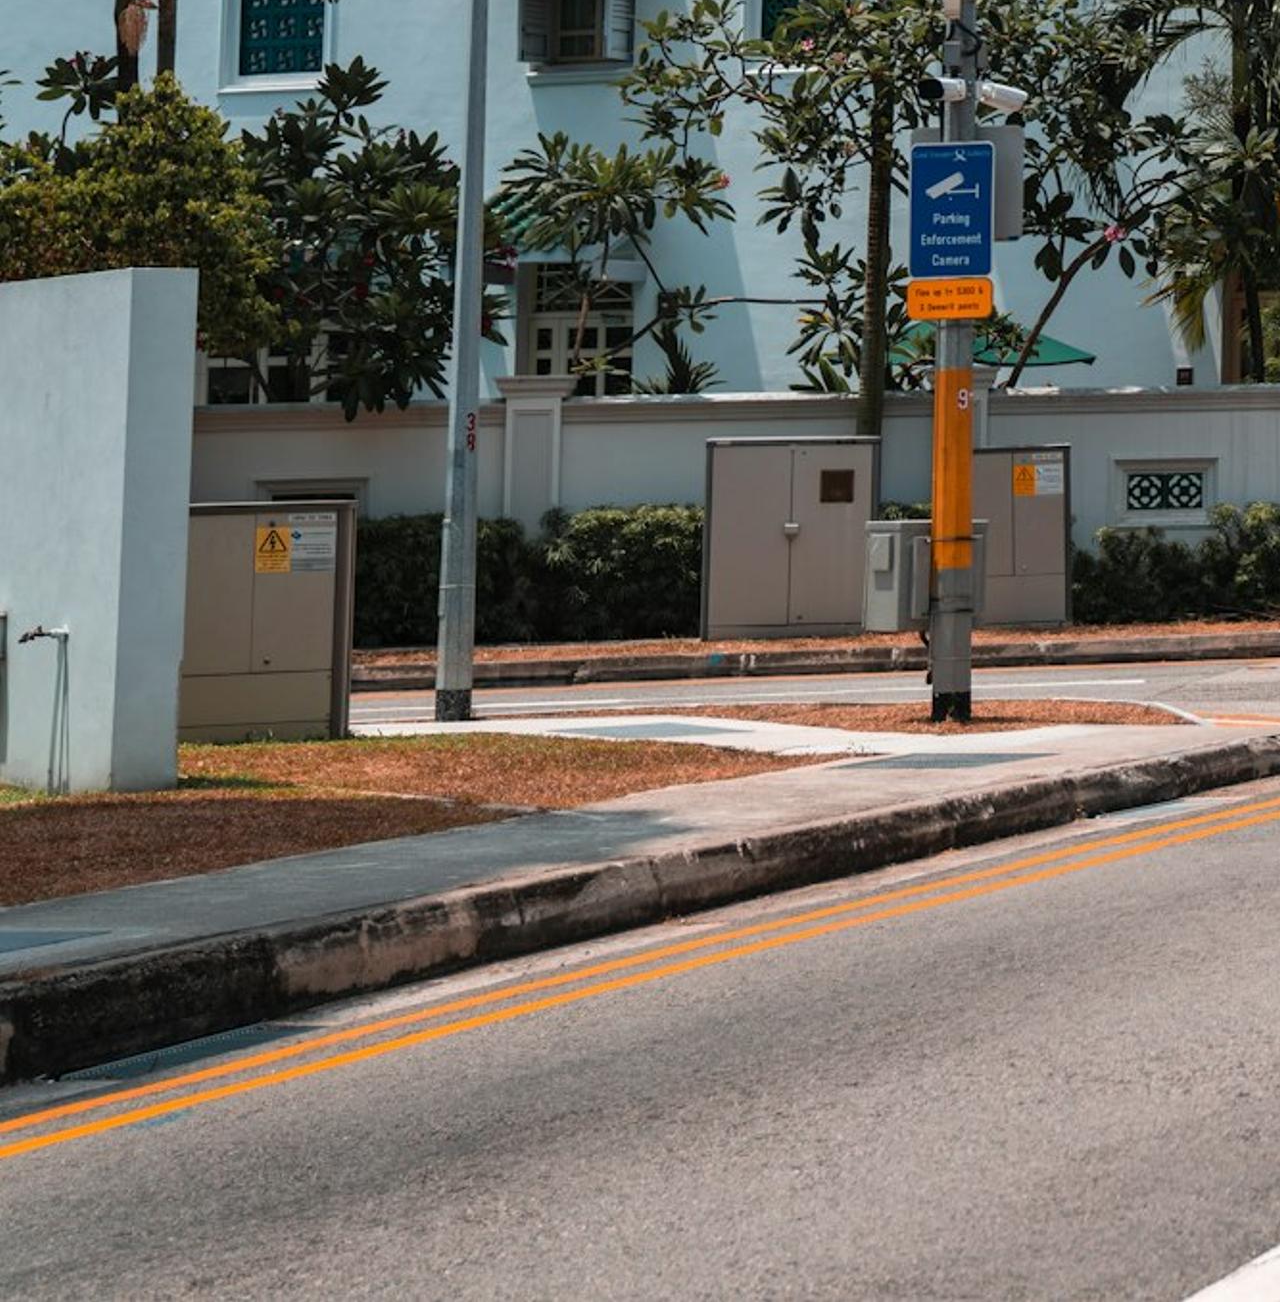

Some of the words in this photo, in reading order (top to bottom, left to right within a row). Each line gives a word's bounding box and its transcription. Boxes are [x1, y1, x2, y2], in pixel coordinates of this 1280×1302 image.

[932, 213, 971, 228] Parking
[921, 232, 982, 246] Enforcement
[932, 254, 970, 266] Camera
